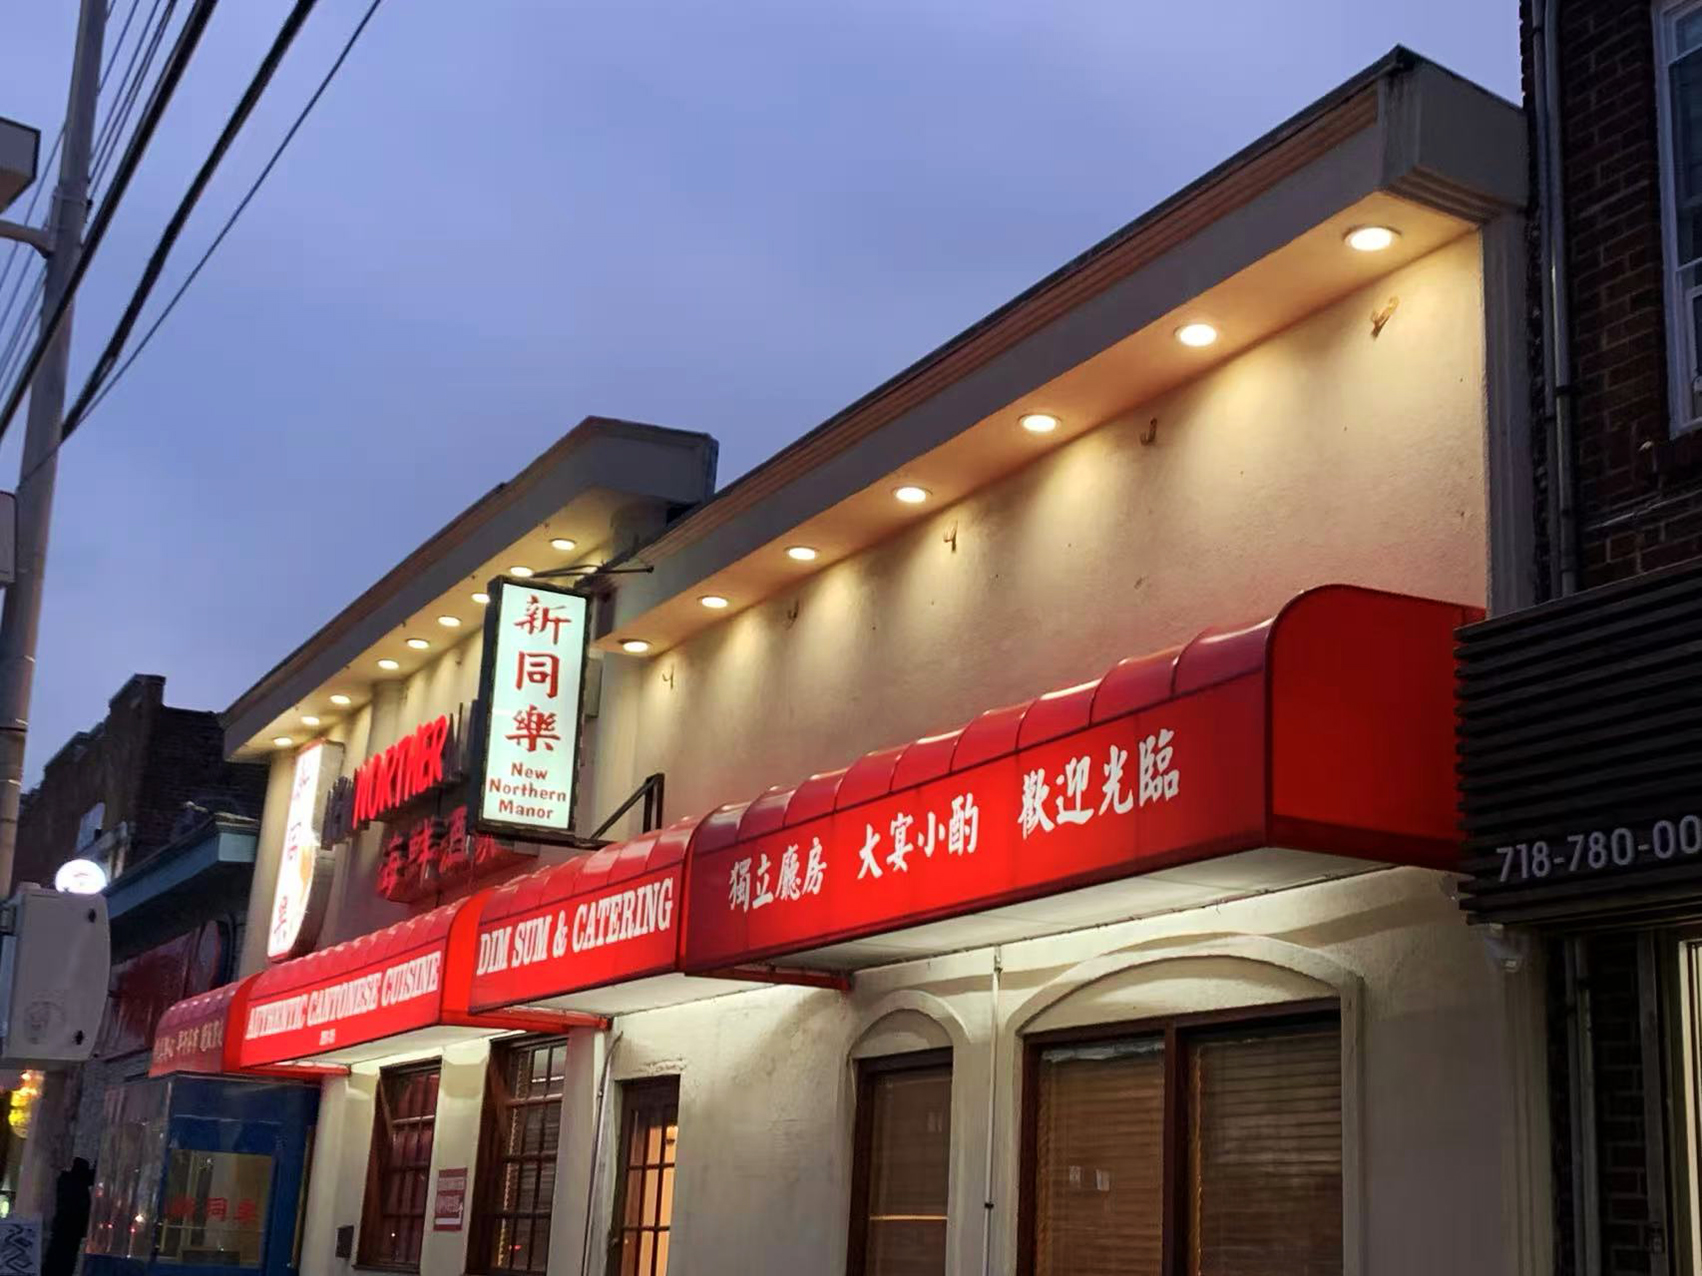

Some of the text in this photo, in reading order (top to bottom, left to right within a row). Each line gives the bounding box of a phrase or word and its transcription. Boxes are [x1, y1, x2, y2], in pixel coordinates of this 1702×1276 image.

[505, 594, 571, 752] 新同樂
[489, 777, 567, 802] Northern
[498, 799, 554, 820] Manor
[511, 762, 548, 780] New
[857, 792, 979, 880] 大宴小酌
[1017, 728, 1180, 840] 歡迎光臨
[476, 877, 674, 976] DIM SUM & CATERING
[245, 1000, 307, 1040] AUTHENTIC
[307, 972, 382, 1027] CANTONESE
[381, 950, 441, 1007] CUISINE
